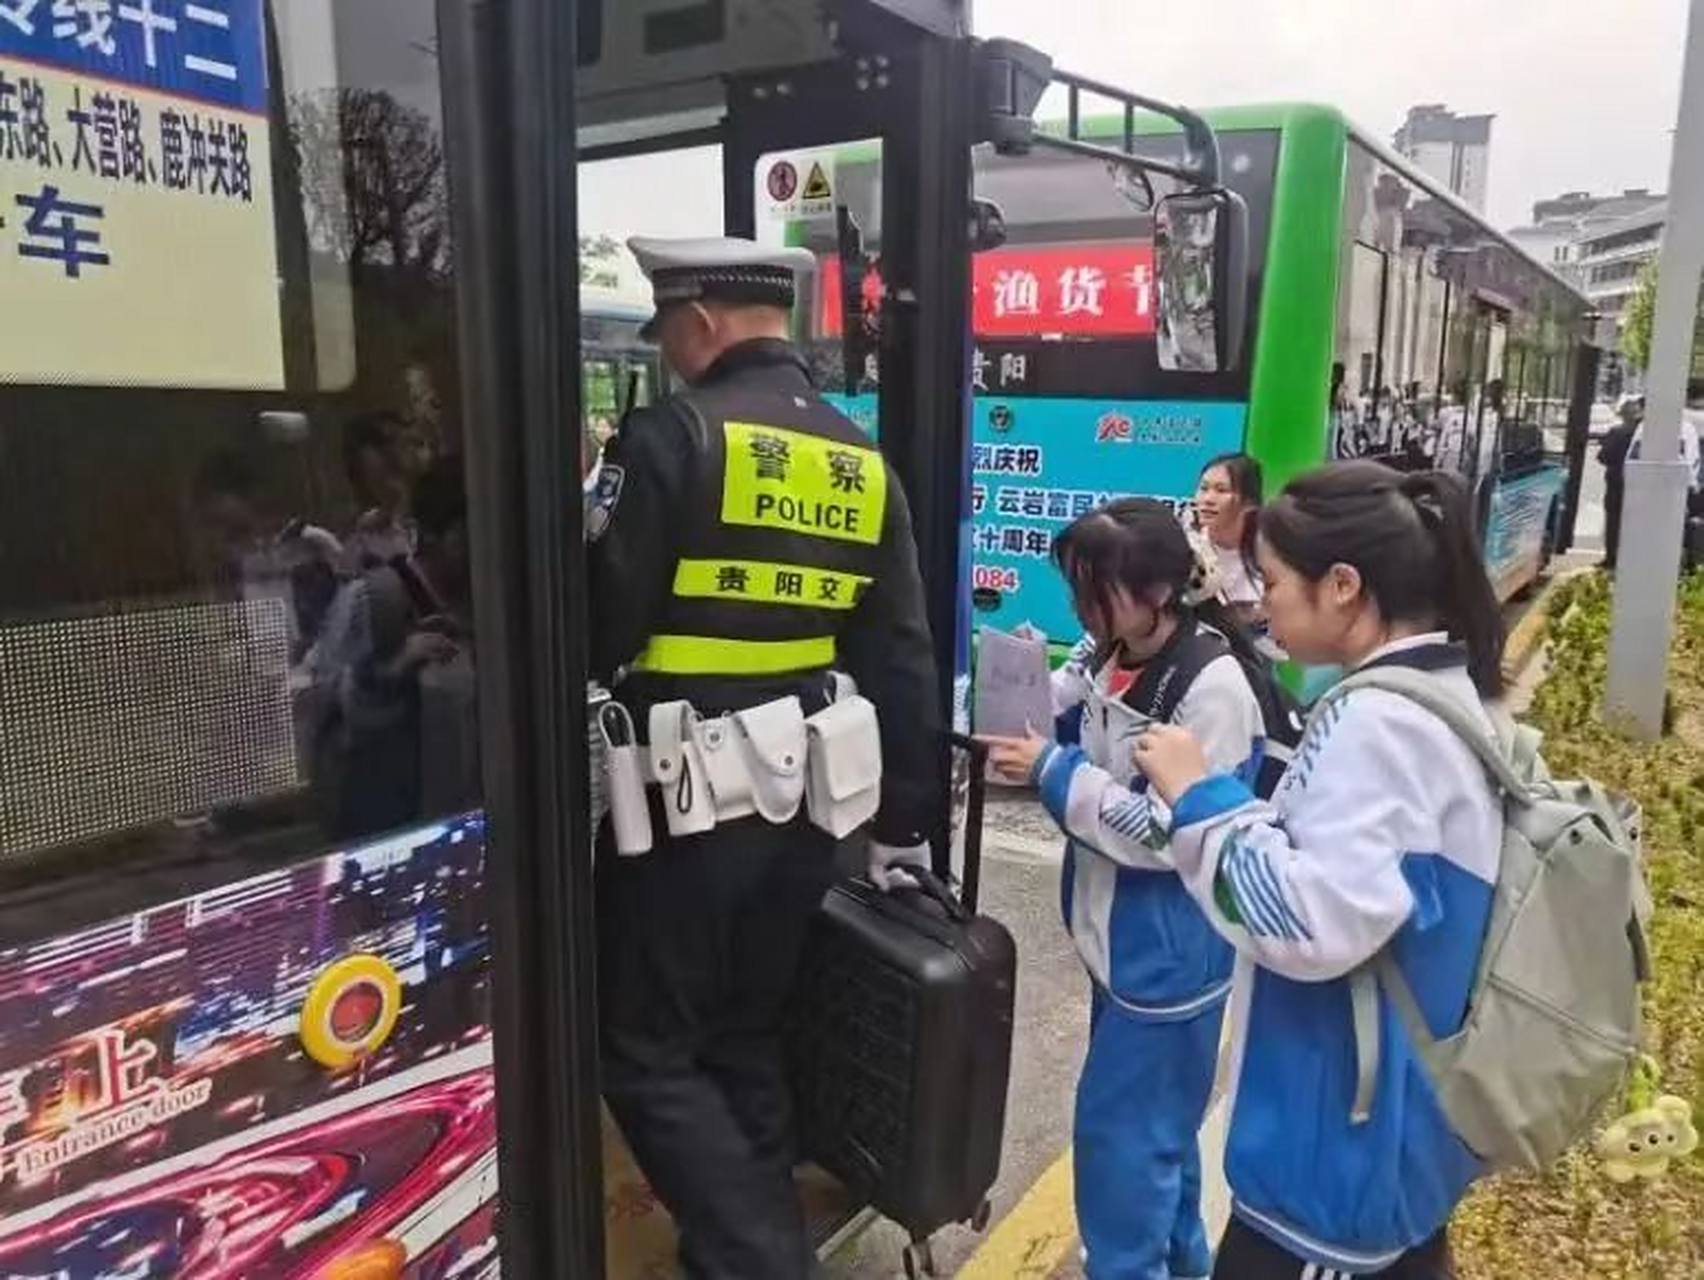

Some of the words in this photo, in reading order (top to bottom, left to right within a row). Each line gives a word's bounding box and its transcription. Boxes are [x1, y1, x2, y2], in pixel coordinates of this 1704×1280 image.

[0, 184, 110, 278] 车
[748, 433, 866, 494] 警察
[755, 493, 860, 532] POLICE
[972, 525, 1050, 557] 十周年
[80, 1028, 169, 1118] 上
[22, 1109, 144, 1174] Entrance
[152, 1085, 208, 1120] door
